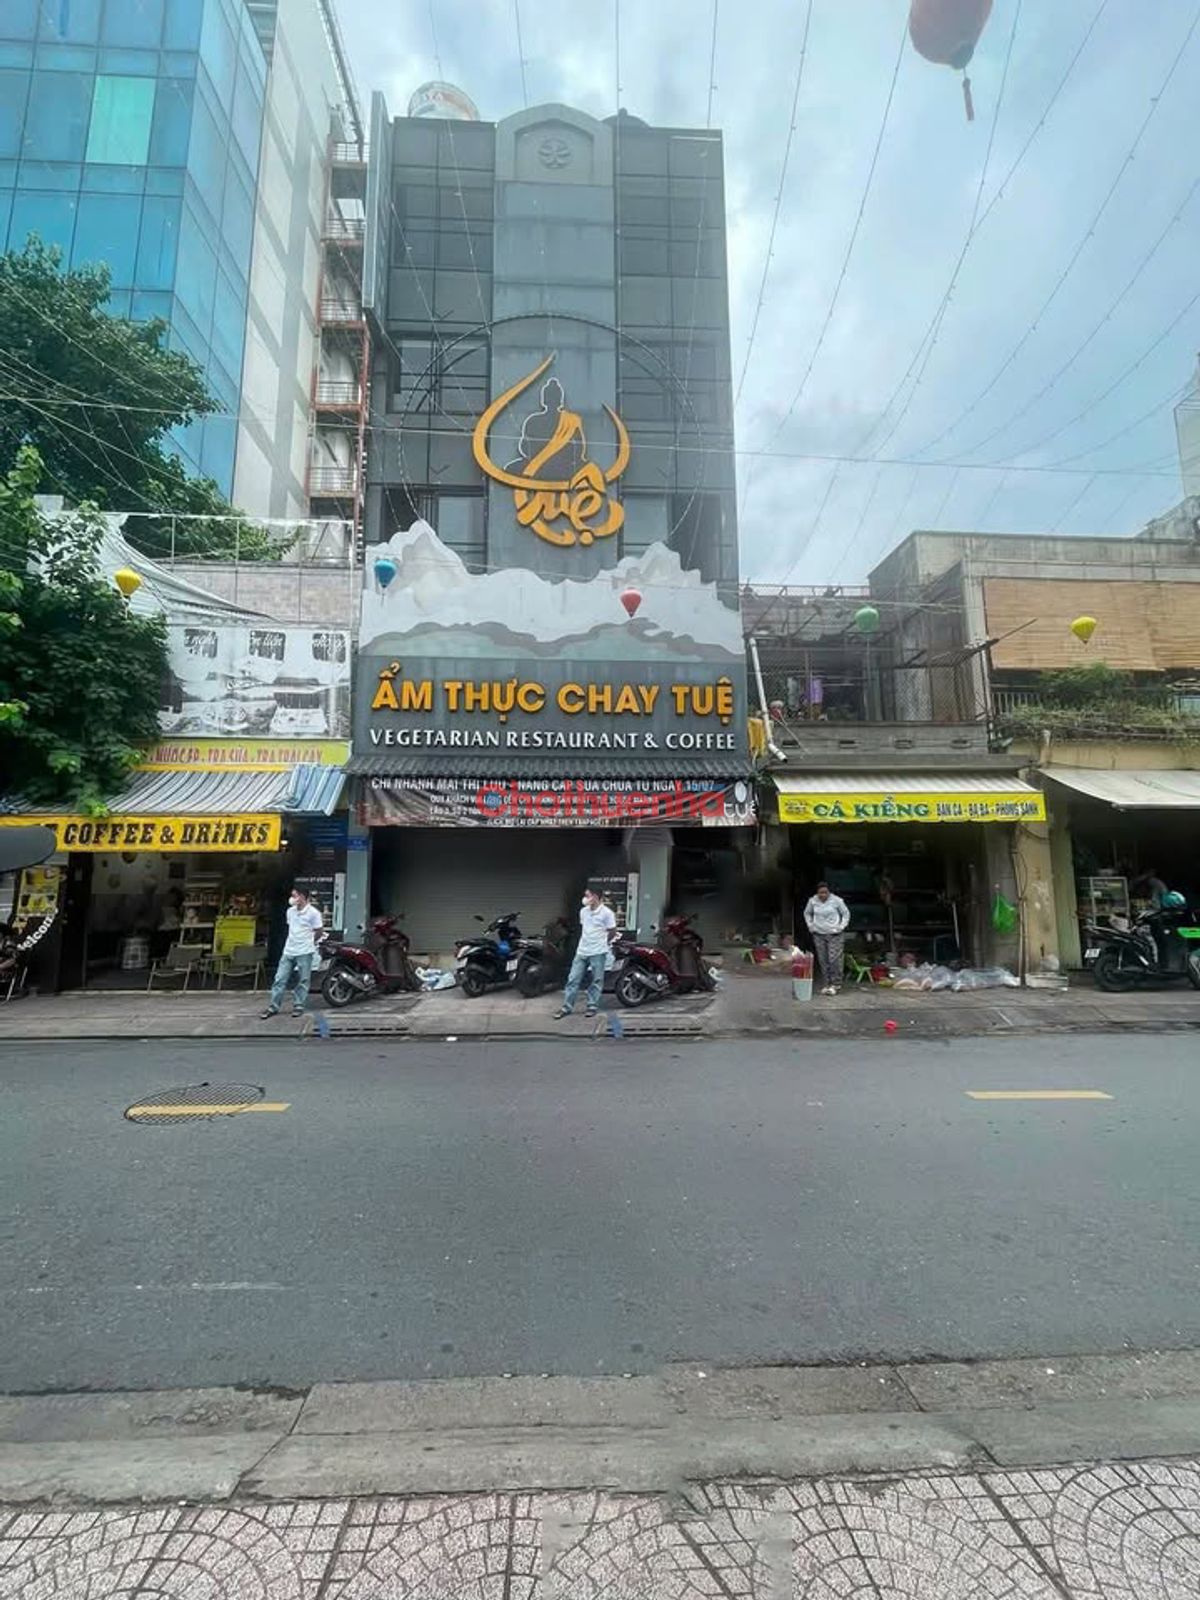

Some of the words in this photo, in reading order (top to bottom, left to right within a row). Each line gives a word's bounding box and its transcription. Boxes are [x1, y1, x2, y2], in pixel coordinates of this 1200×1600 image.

[371, 661, 433, 711] ẨM
[444, 677, 546, 723] THỰC
[556, 682, 660, 715] CHAY
[671, 676, 734, 725] TUỆ
[369, 728, 500, 747] VEGETARIAN
[506, 730, 639, 749] RESTAURANT
[643, 732, 660, 749] &
[665, 732, 736, 750] COFFEE
[63, 823, 156, 845] COFFEE
[160, 825, 175, 845] &
